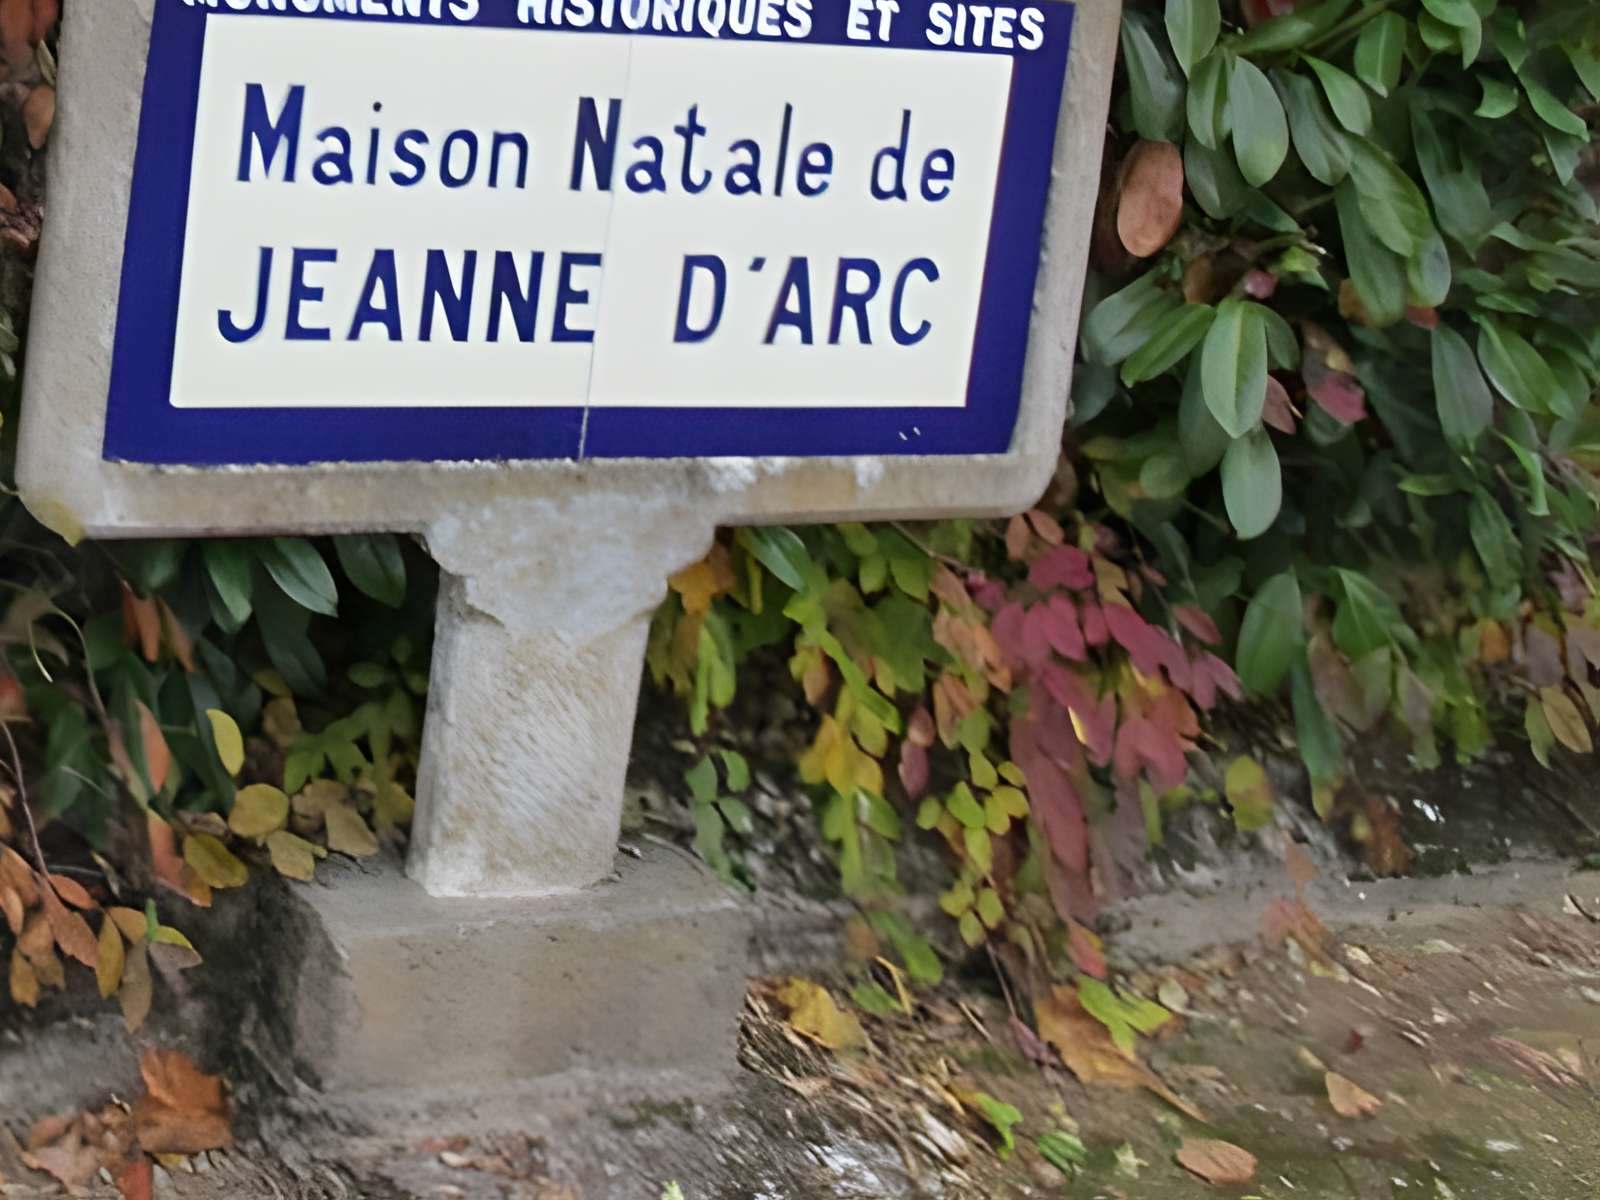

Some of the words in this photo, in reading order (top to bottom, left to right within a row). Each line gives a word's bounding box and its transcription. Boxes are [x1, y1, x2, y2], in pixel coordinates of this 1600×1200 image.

[925, 2, 1046, 51] SITES
[236, 81, 529, 190] Maison
[568, 95, 835, 199] Natale
[869, 108, 956, 203] de
[217, 245, 604, 345] JEANNE
[672, 253, 941, 347] D'ARC
